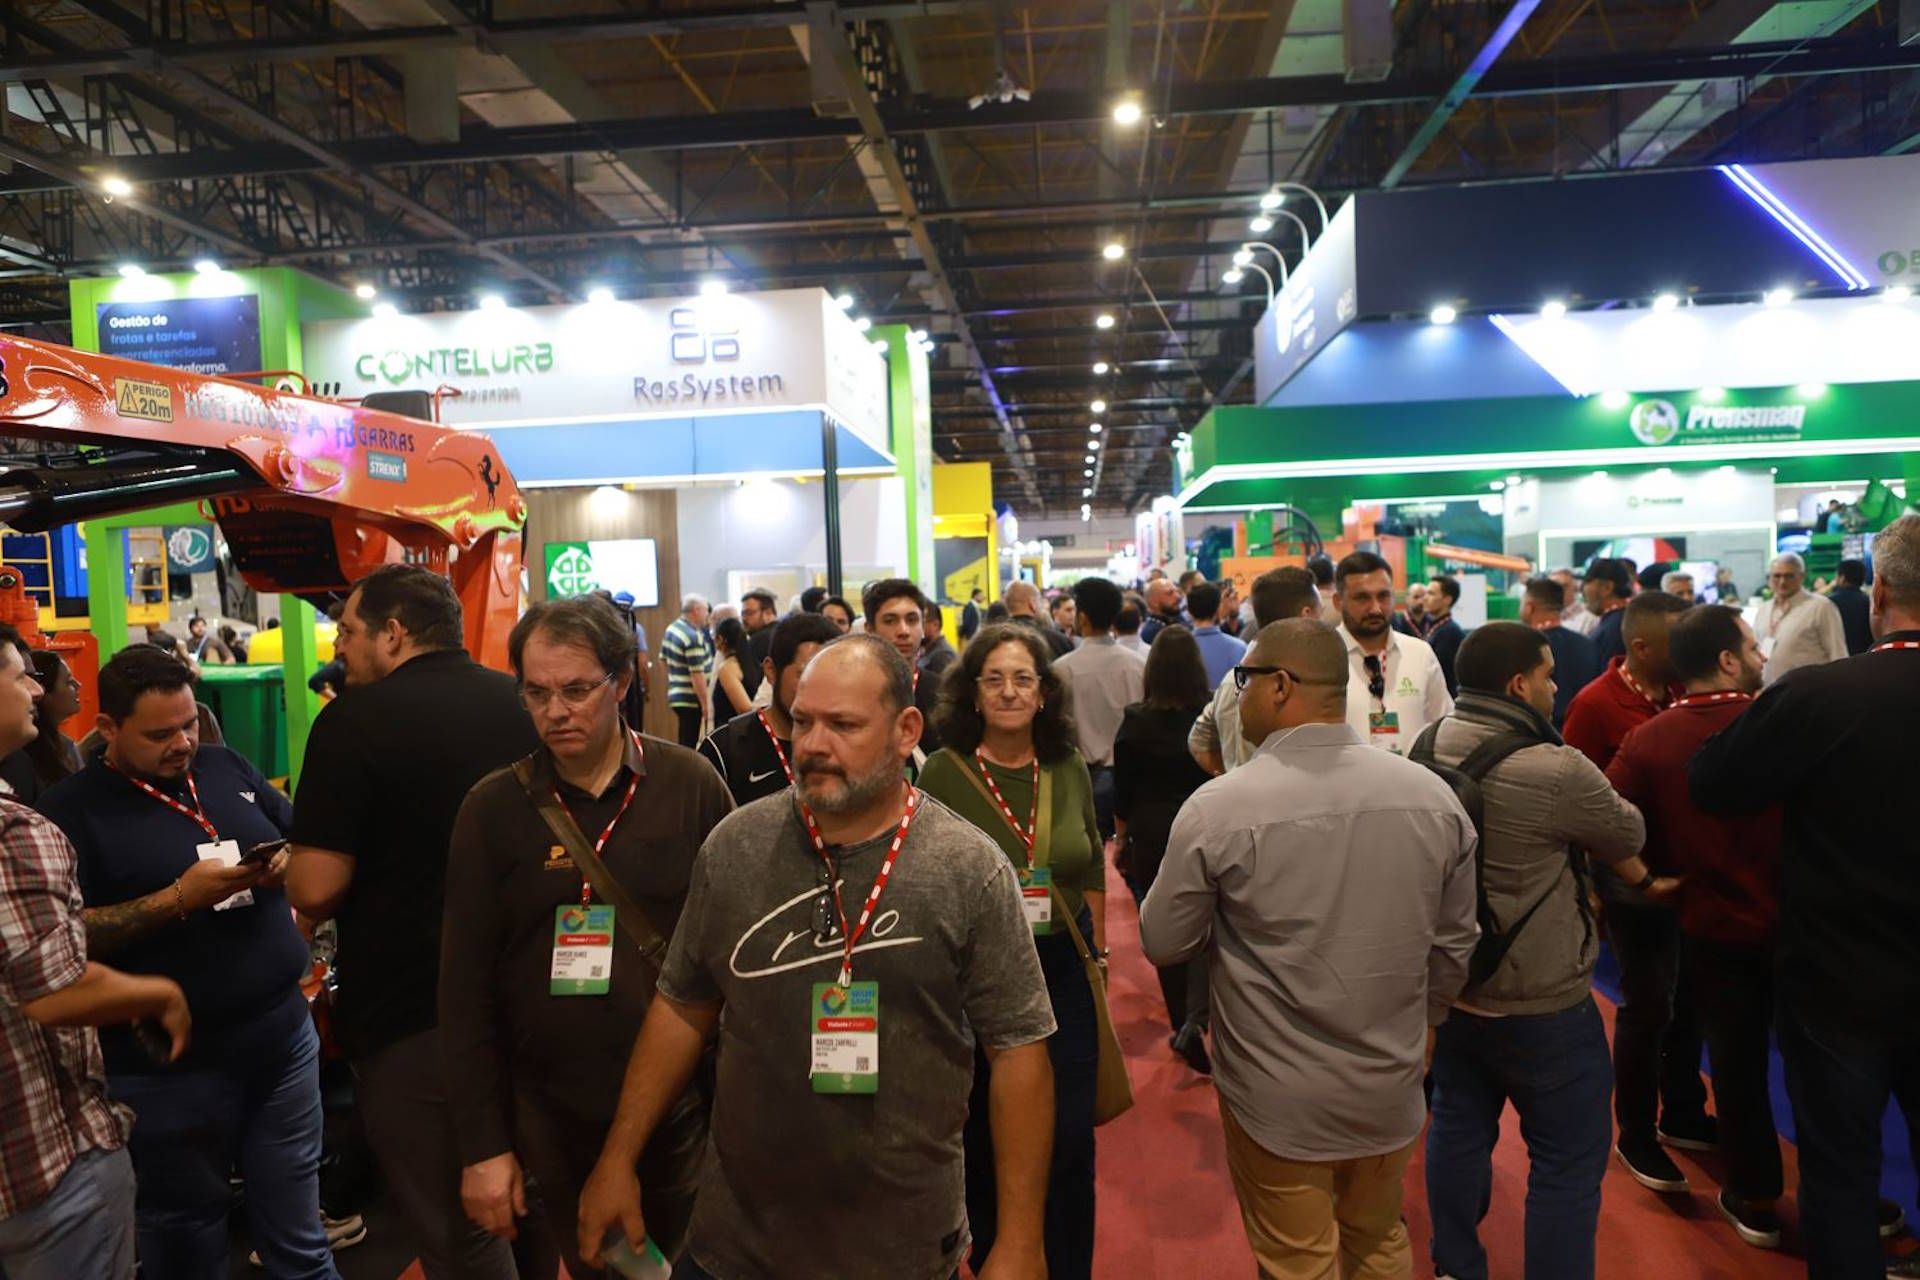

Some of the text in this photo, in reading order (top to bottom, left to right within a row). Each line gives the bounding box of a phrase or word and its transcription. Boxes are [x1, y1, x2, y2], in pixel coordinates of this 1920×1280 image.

[152, 314, 168, 326] de
[146, 335, 155, 343] e
[156, 330, 197, 343] tarefas
[355, 343, 553, 384] CONTELURB
[132, 383, 169, 398] PERIGO
[633, 373, 783, 402] RasSystem
[140, 398, 171, 418] 20m
[357, 424, 415, 452] GARRAS
[369, 461, 401, 475] STRENX
